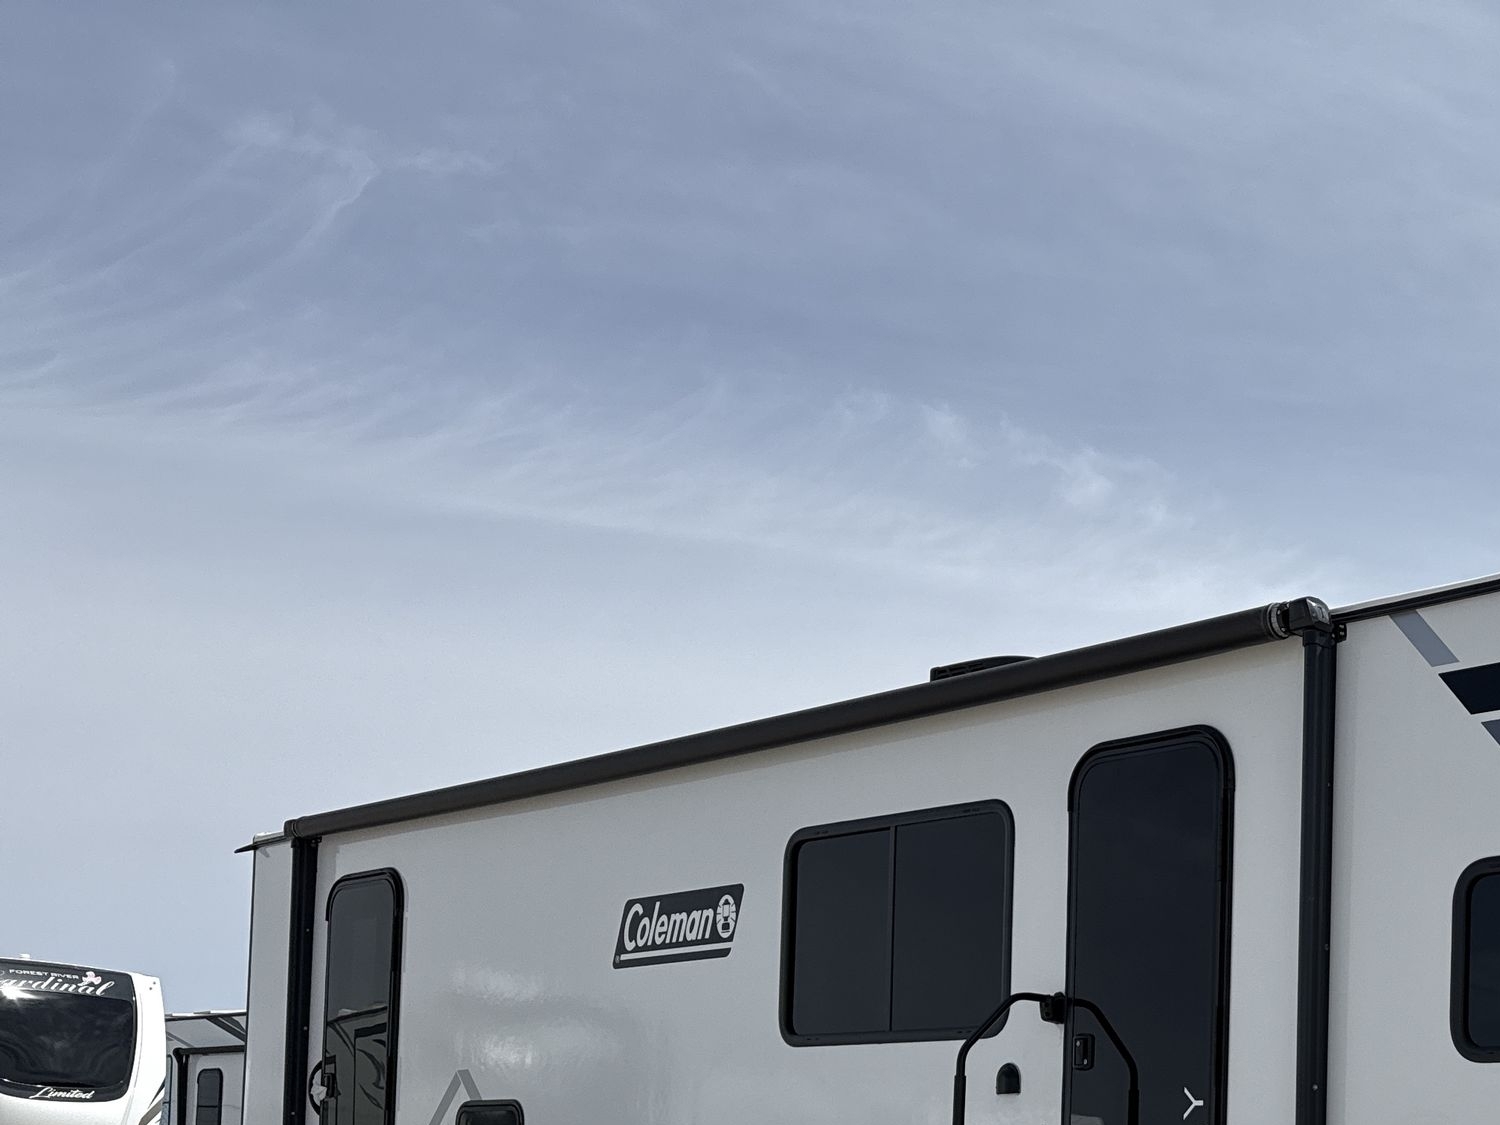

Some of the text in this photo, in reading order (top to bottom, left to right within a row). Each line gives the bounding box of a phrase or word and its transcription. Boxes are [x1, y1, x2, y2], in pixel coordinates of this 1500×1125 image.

[623, 901, 715, 952] Coleman
[9, 968, 80, 980] FOREST RIVER
[0, 976, 115, 996] ardinal
[29, 1087, 95, 1100] Limited
